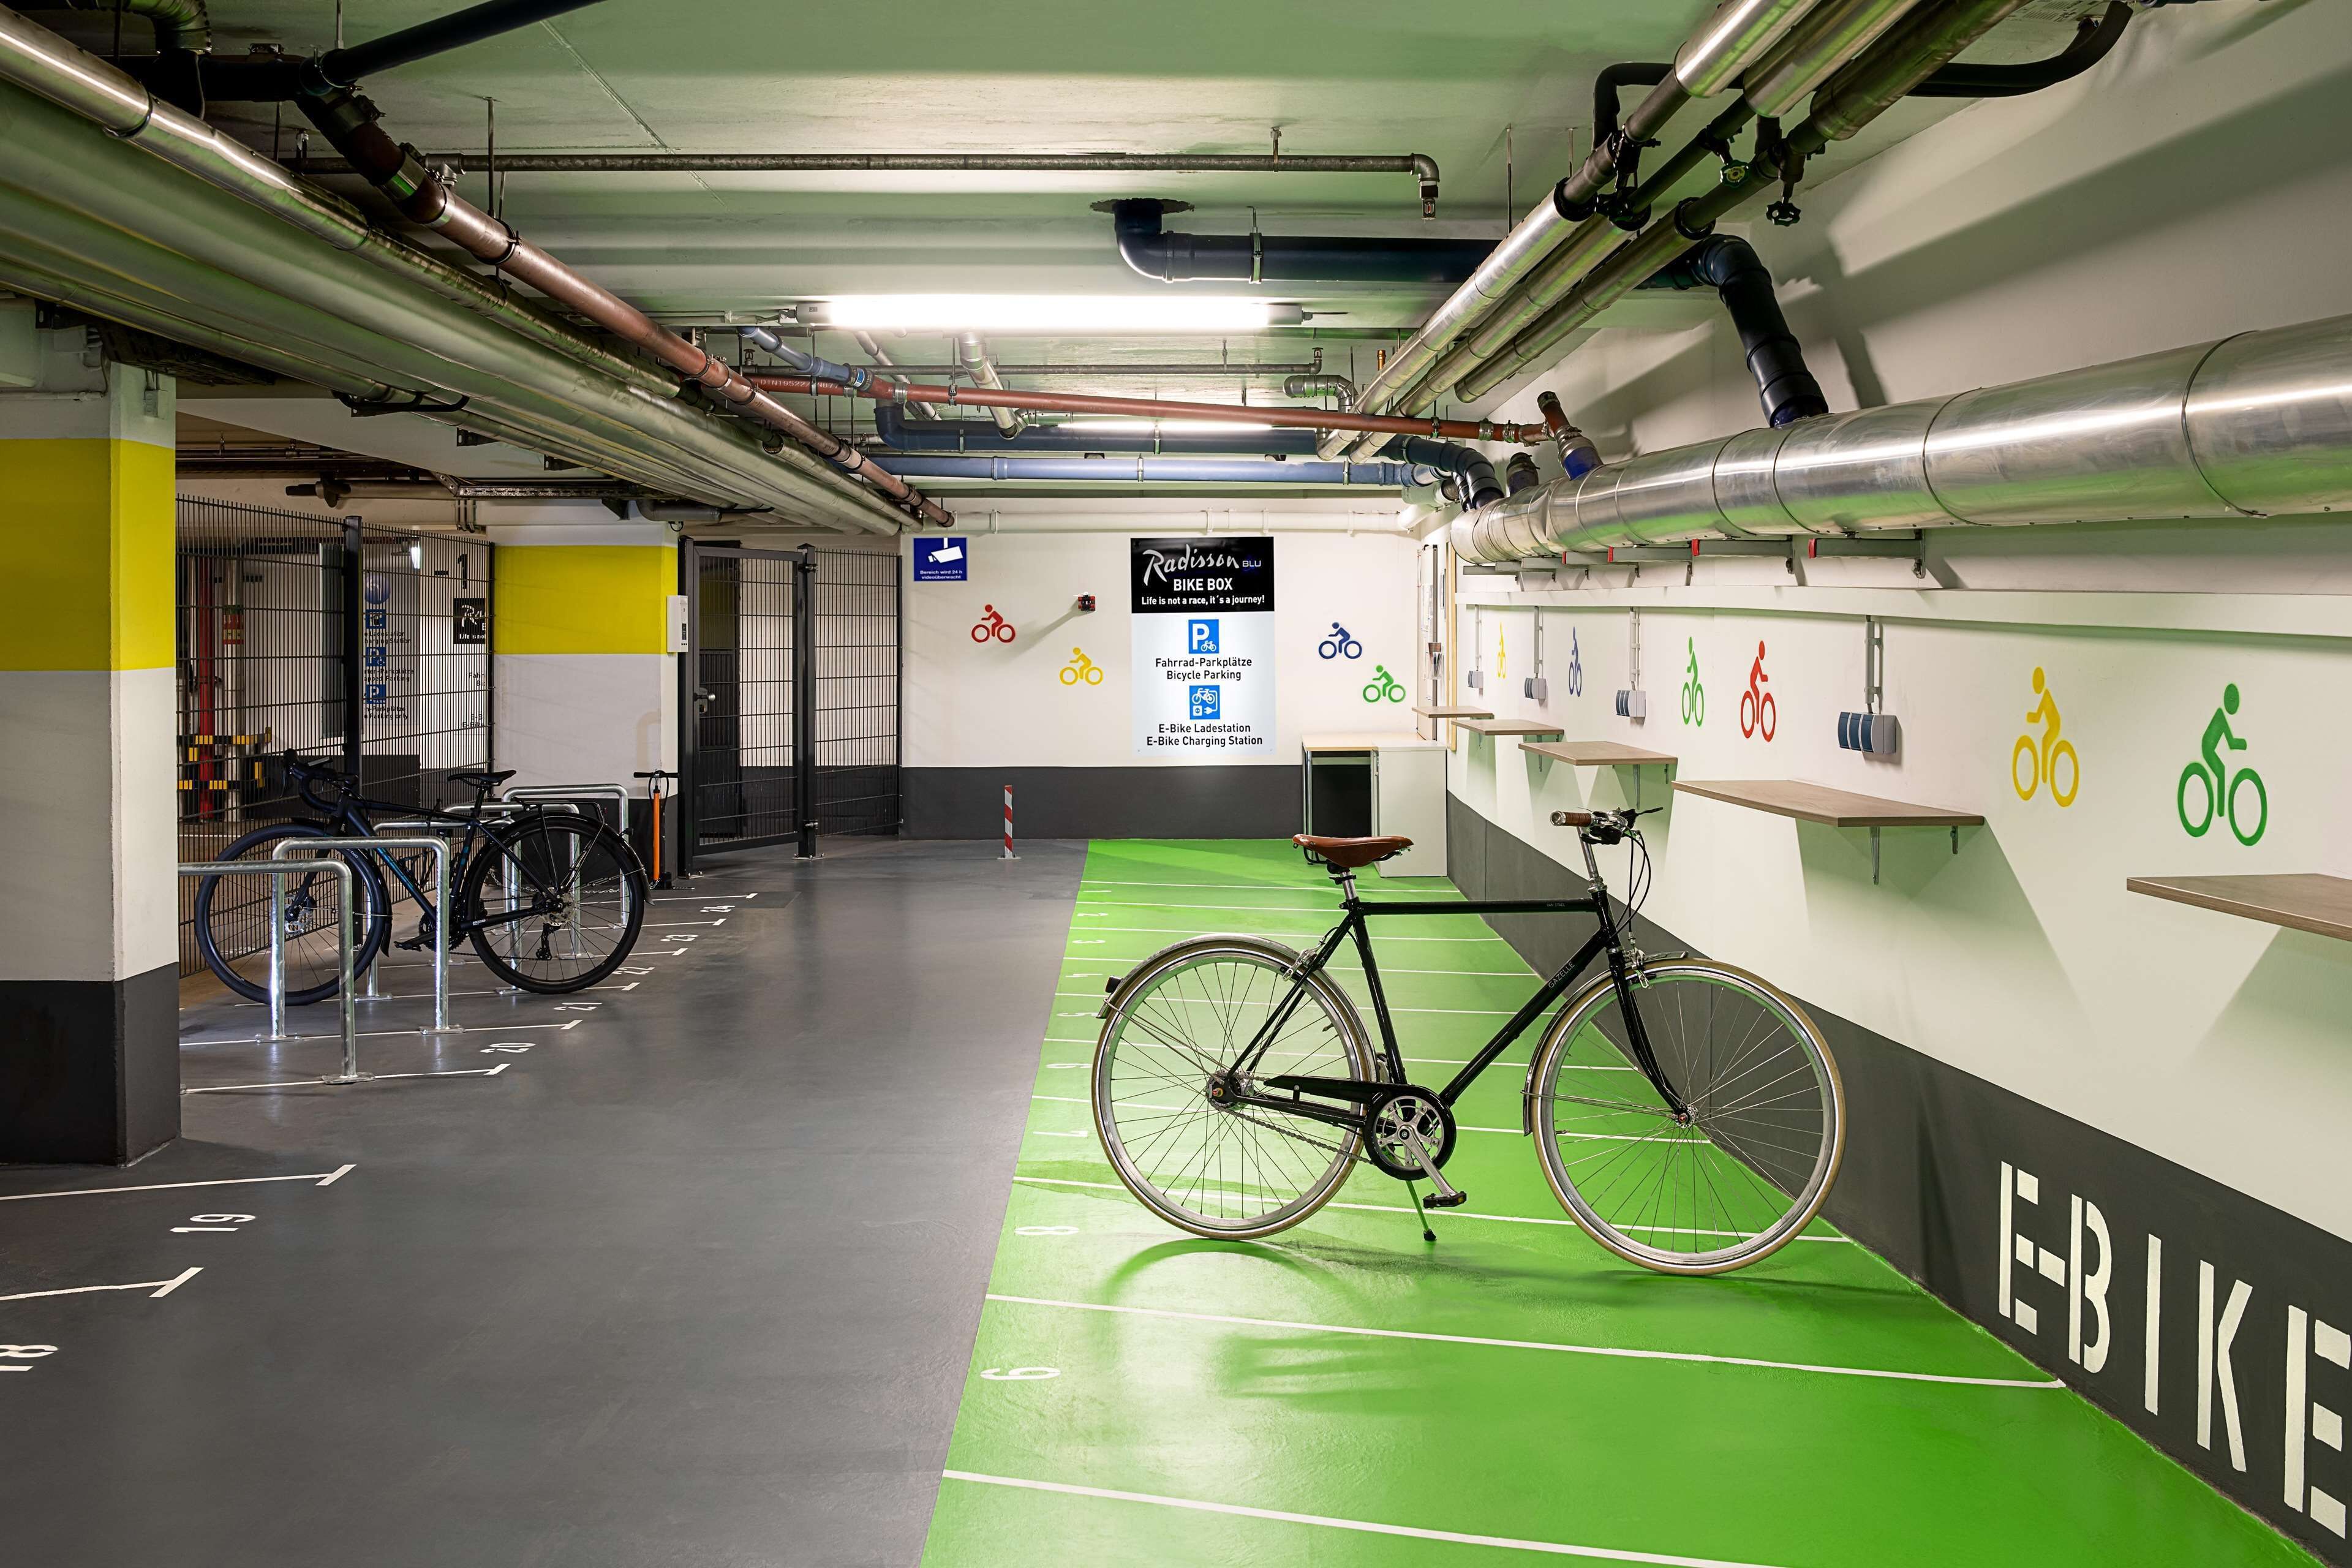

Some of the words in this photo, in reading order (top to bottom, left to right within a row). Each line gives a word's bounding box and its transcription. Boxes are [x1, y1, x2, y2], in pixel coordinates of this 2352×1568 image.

[1142, 543, 1239, 586] Radisson
[1174, 579, 1204, 591] BIKE
[1207, 578, 1233, 590] BOX
[1142, 596, 1157, 605] Life
[1231, 595, 1265, 605] journey!
[1156, 657, 1252, 668] Fahrrad-Parkplätze
[1167, 671, 1200, 681] Bicycle
[1204, 670, 1241, 680] Parking
[1159, 724, 1191, 733] E-Bike
[1194, 723, 1251, 733] Ladestation
[1147, 736, 1180, 745] E-Bike
[1182, 736, 1226, 747] Charging
[1229, 736, 1262, 745] Station
[1548, 960, 1575, 988] GAZELLE
[170, 1213, 255, 1232] 19
[1999, 1161, 2351, 1540] E-BIKE
